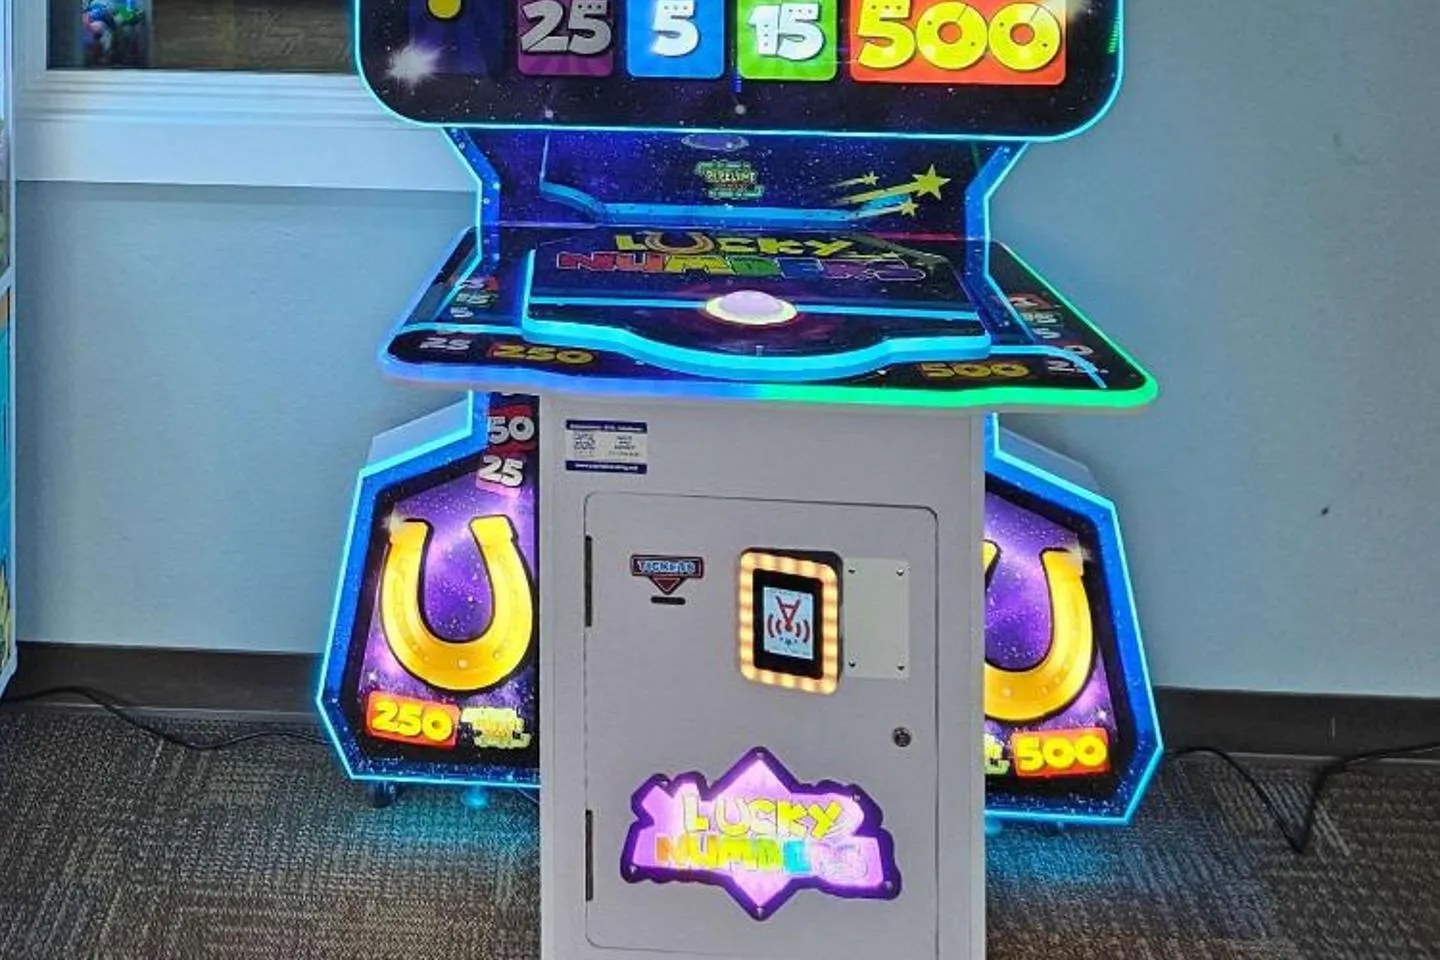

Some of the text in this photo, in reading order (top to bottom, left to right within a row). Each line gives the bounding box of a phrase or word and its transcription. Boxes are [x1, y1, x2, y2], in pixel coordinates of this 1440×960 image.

[747, 1, 824, 60] 15
[420, 337, 472, 351] 25
[491, 344, 597, 365] 250
[920, 362, 1031, 378] 500
[487, 415, 535, 444] 50
[478, 454, 524, 487] 25
[370, 698, 453, 742] 250
[1017, 734, 1108, 772] 500
[682, 792, 844, 839] LUCKY
